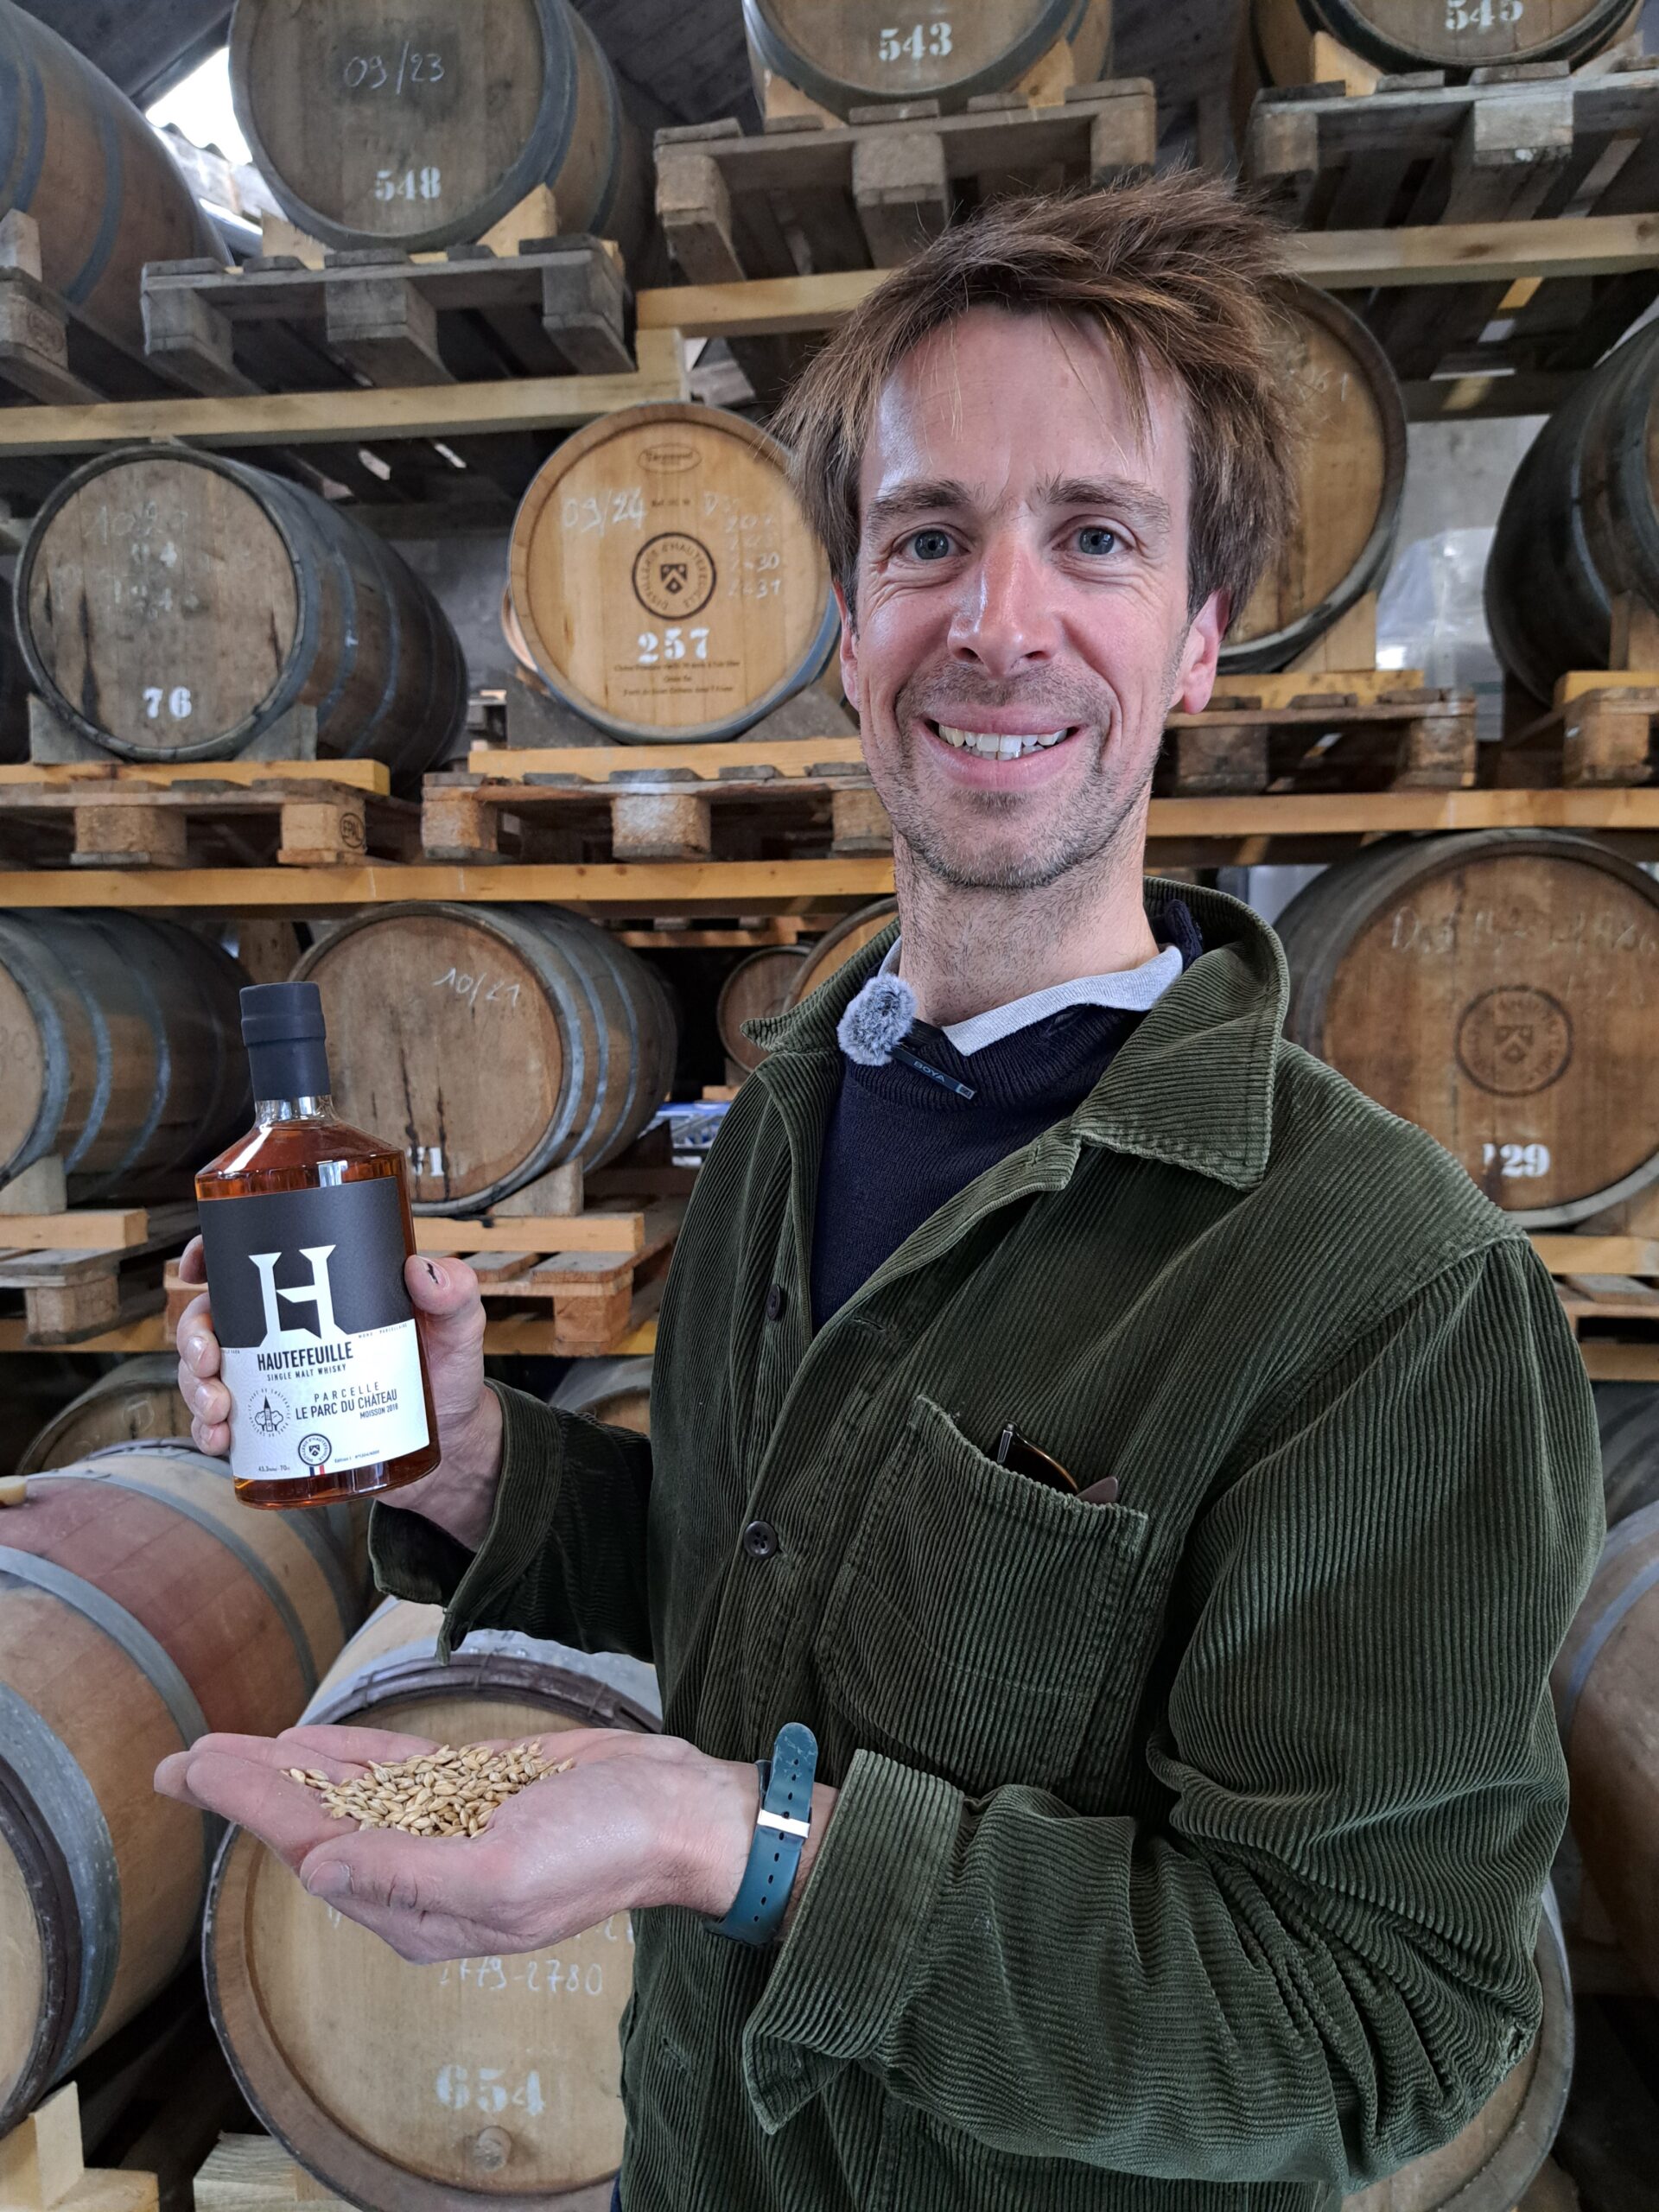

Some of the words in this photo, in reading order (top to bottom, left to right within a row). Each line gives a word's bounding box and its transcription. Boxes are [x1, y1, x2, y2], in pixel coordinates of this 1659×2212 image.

[879, 22, 953, 61] 543
[345, 41, 445, 95] 09/23
[374, 166, 442, 201] 548
[562, 486, 649, 538] 09/24
[637, 626, 710, 664] 257
[142, 685, 193, 719] 76
[913, 1060, 945, 1083] BOYA
[248, 1244, 347, 1348] H
[257, 1341, 354, 1371] HAUTEFEUILLE
[266, 1371, 292, 1382] SINGLE
[295, 1369, 314, 1379] MALT
[317, 1363, 346, 1376] WHISKY
[314, 1382, 379, 1402] PARCELLE
[295, 1407, 308, 1421] LE
[310, 1402, 338, 1418] PARC
[340, 1398, 355, 1413] DU
[359, 1408, 385, 1420] MOISSON
[385, 1402, 399, 1414] 2018
[435, 2063, 546, 2115] 654
